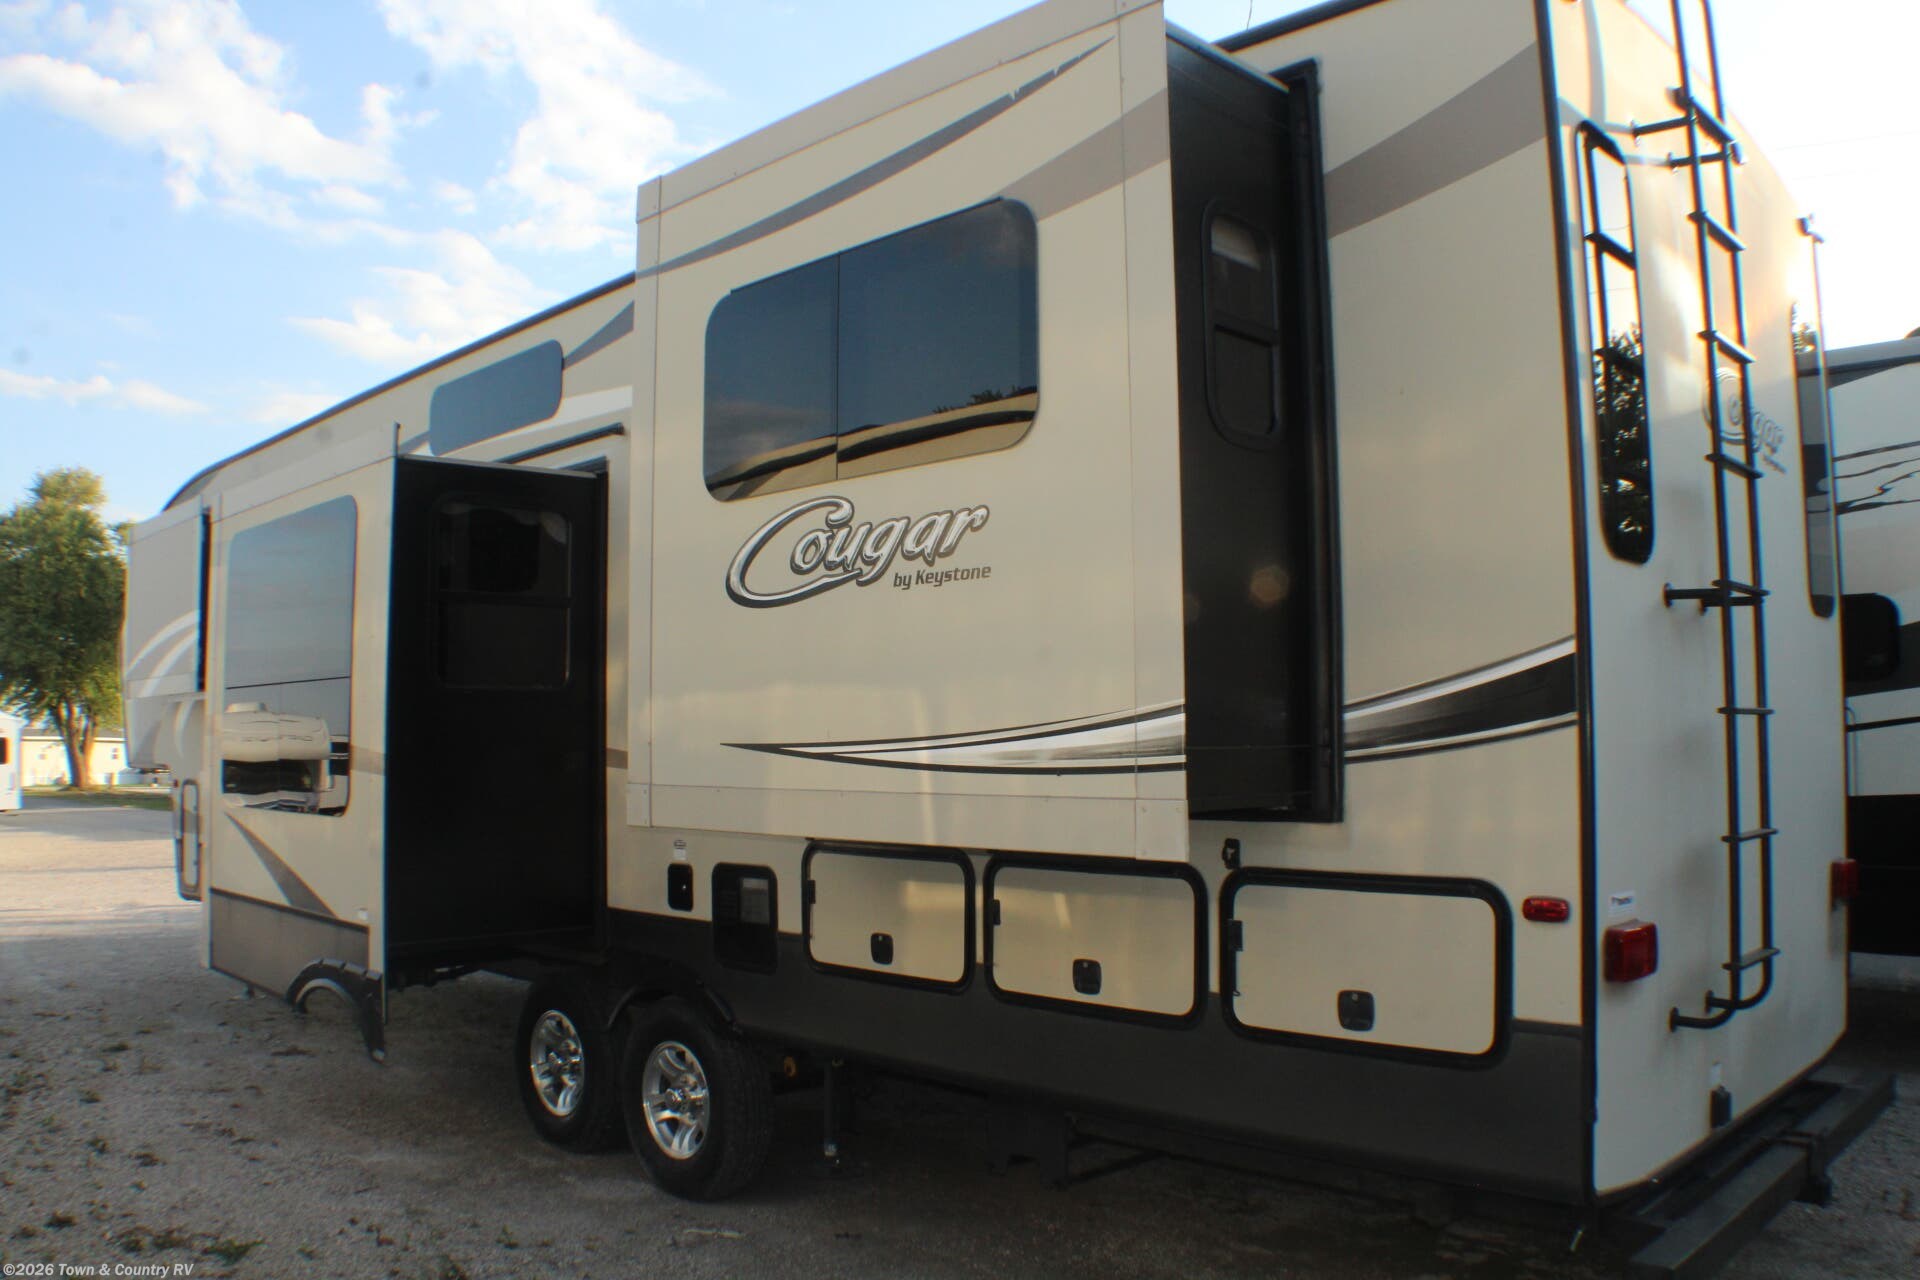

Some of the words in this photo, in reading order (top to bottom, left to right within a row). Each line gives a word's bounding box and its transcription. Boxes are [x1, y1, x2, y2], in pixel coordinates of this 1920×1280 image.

[726, 495, 990, 608] Cougar
[893, 572, 912, 590] by
[915, 566, 992, 587] Keystone
